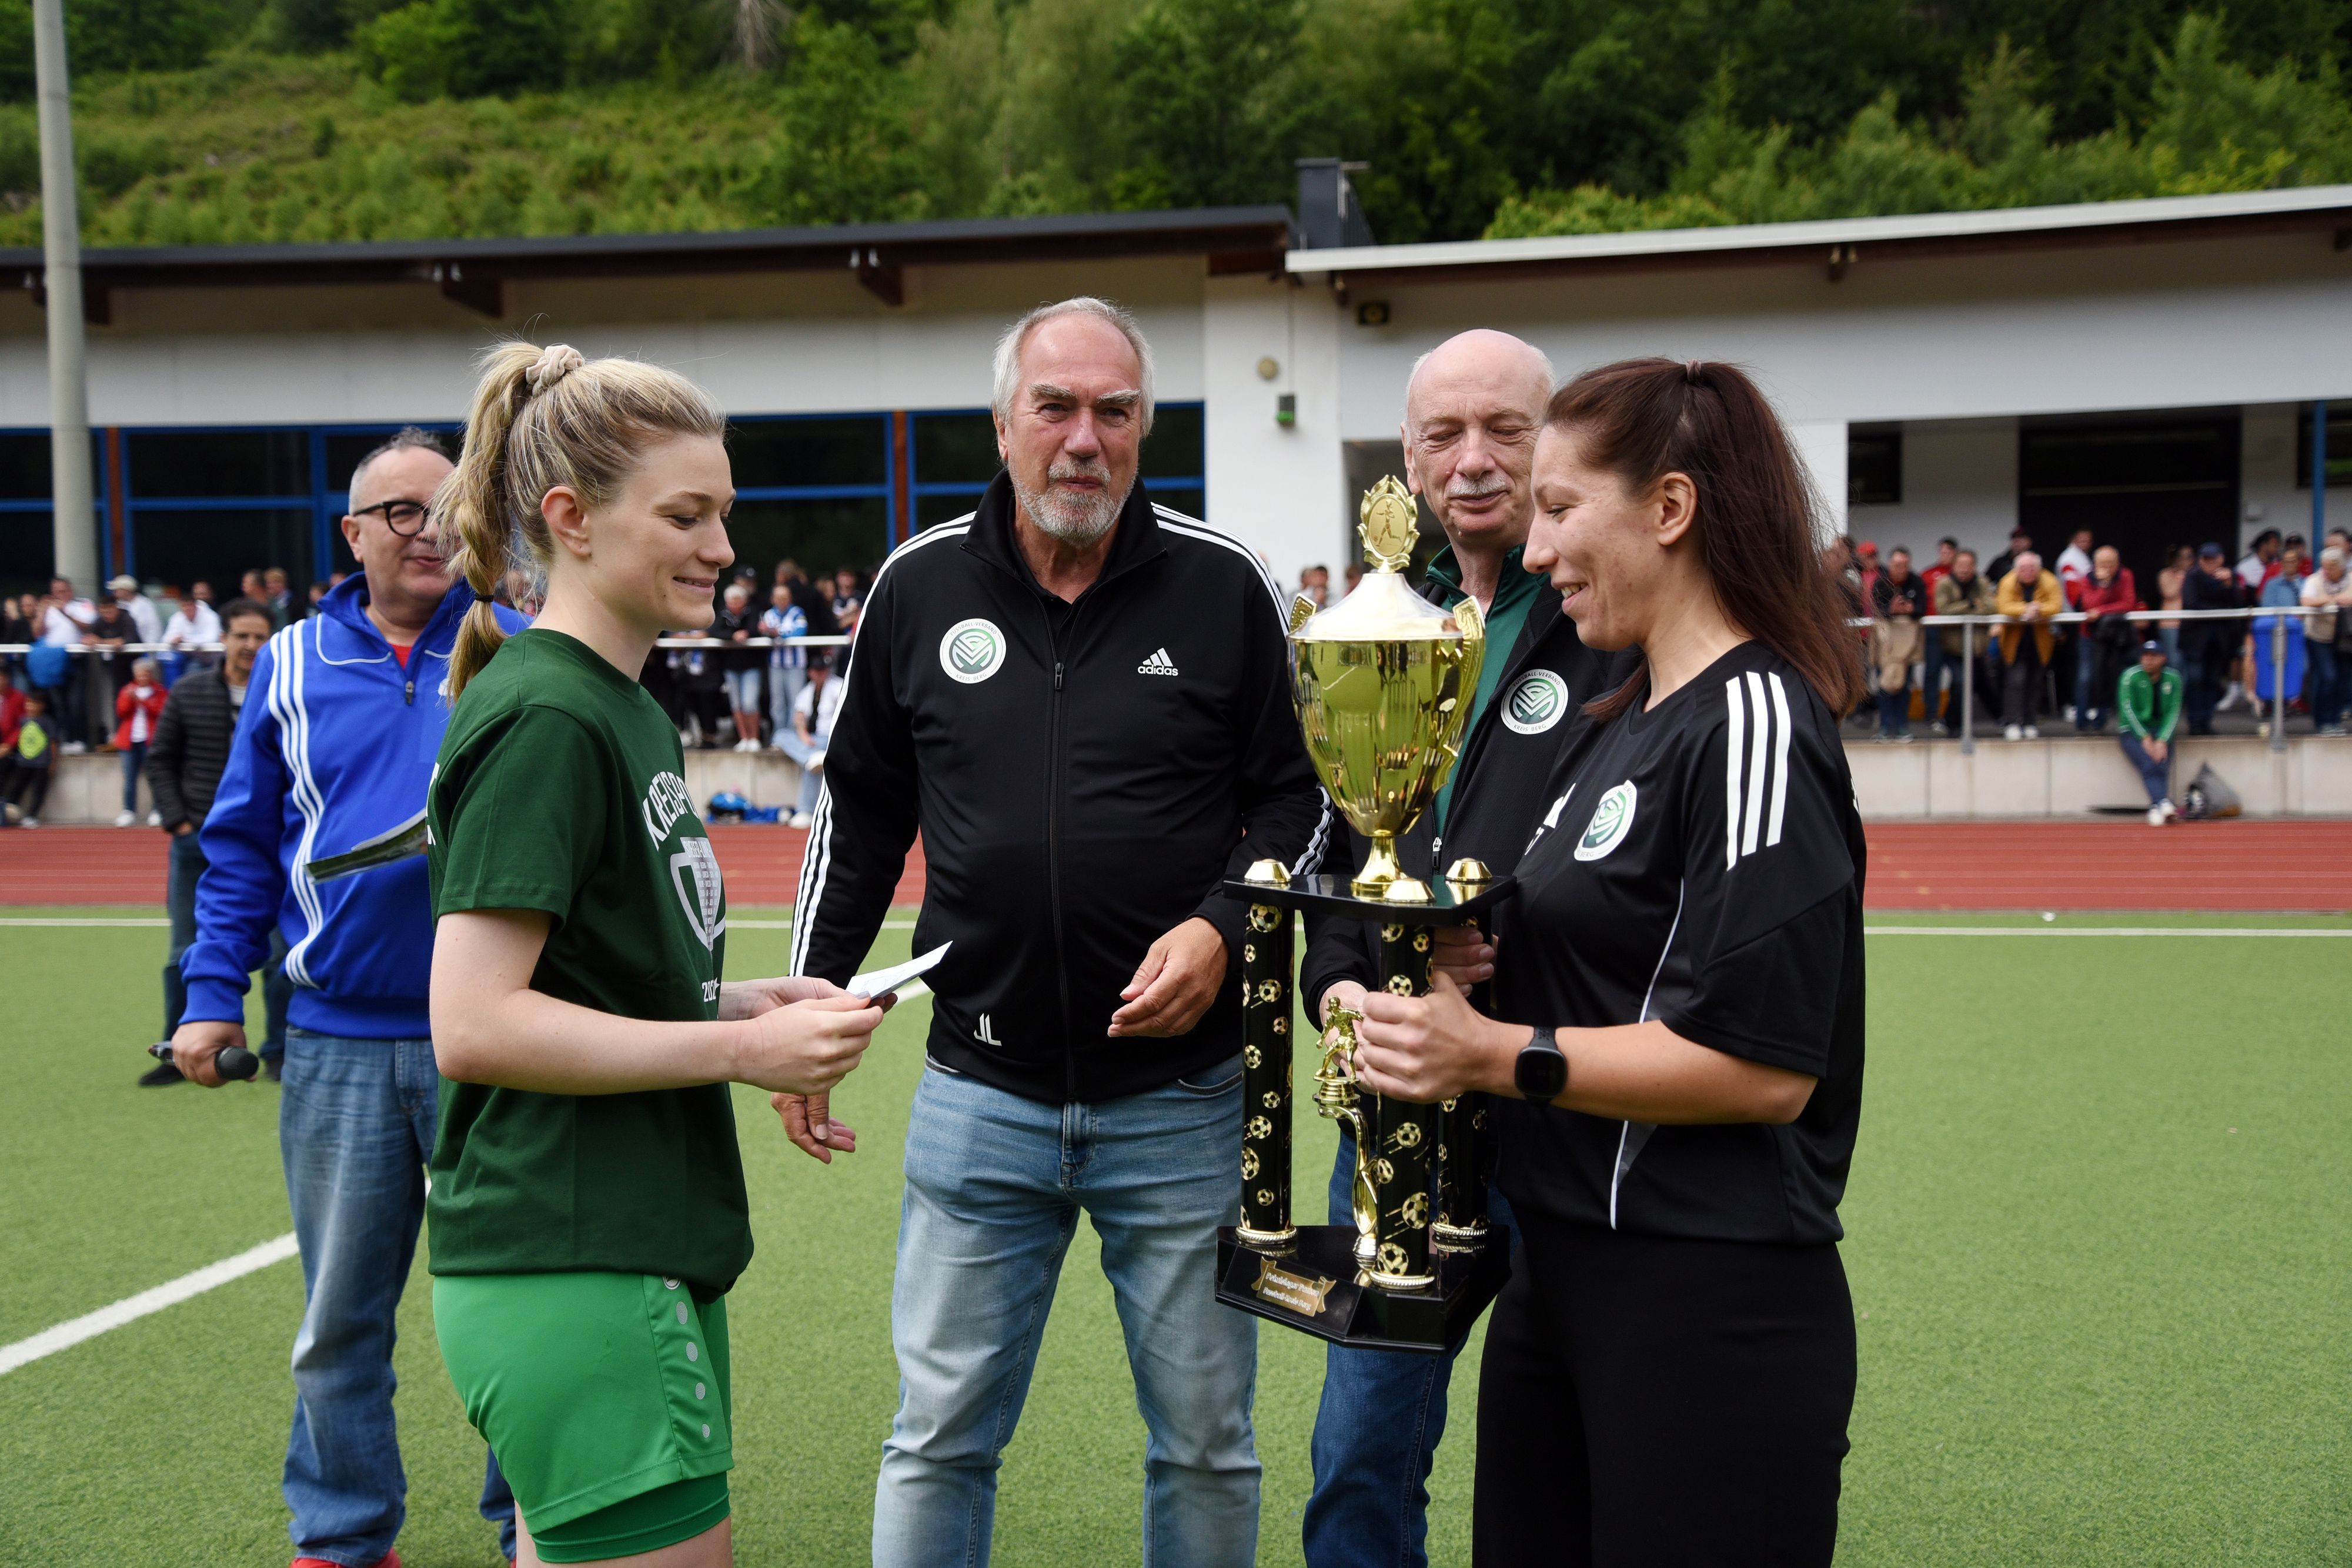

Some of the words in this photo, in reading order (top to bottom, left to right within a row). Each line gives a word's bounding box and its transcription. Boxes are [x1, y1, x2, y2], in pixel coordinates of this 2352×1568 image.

[950, 621, 997, 636] FUSSBALL-VERBAND
[1137, 664, 1178, 676] adidas
[956, 673, 970, 681] KREIS
[973, 673, 987, 681] BERG
[1513, 671, 1561, 687] FUSSBALL-VERBAND
